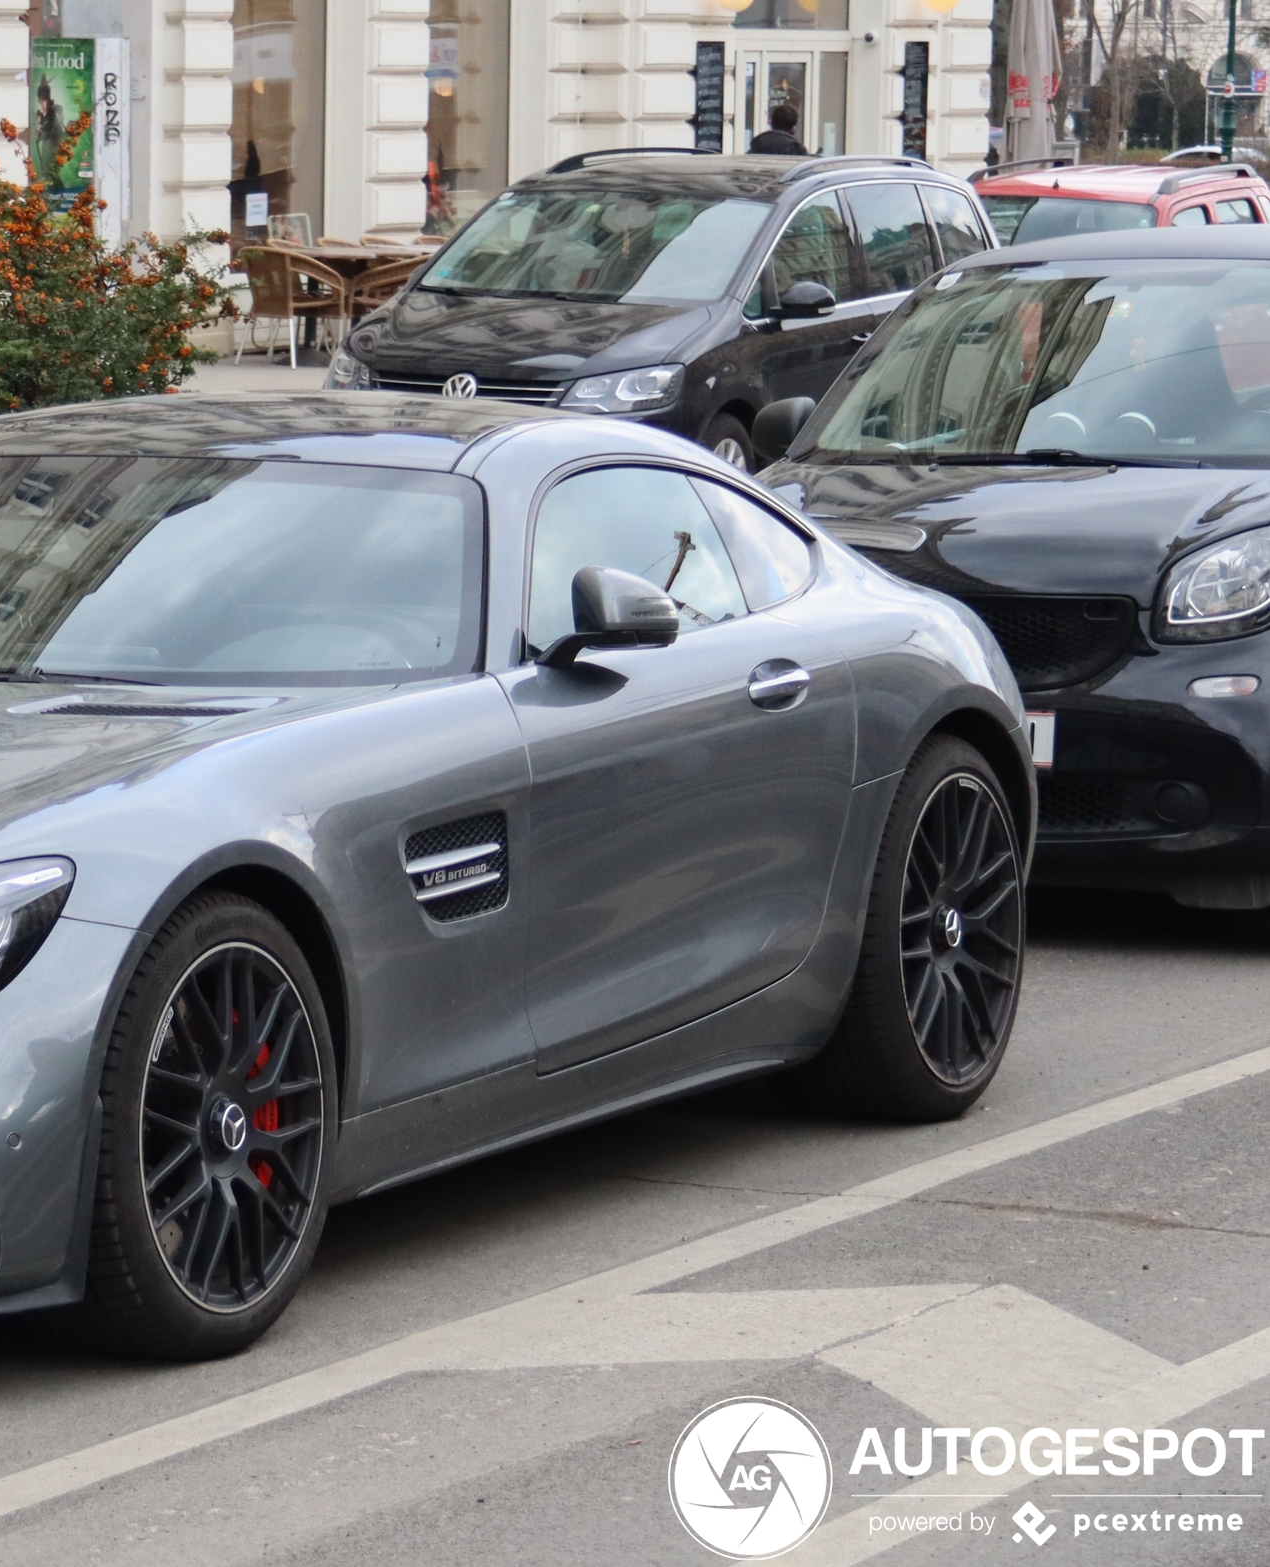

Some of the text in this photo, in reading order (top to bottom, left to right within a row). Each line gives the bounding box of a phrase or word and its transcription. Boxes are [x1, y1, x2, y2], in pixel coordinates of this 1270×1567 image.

[47, 51, 85, 70] Hood
[422, 863, 487, 887] V8 BITURBO
